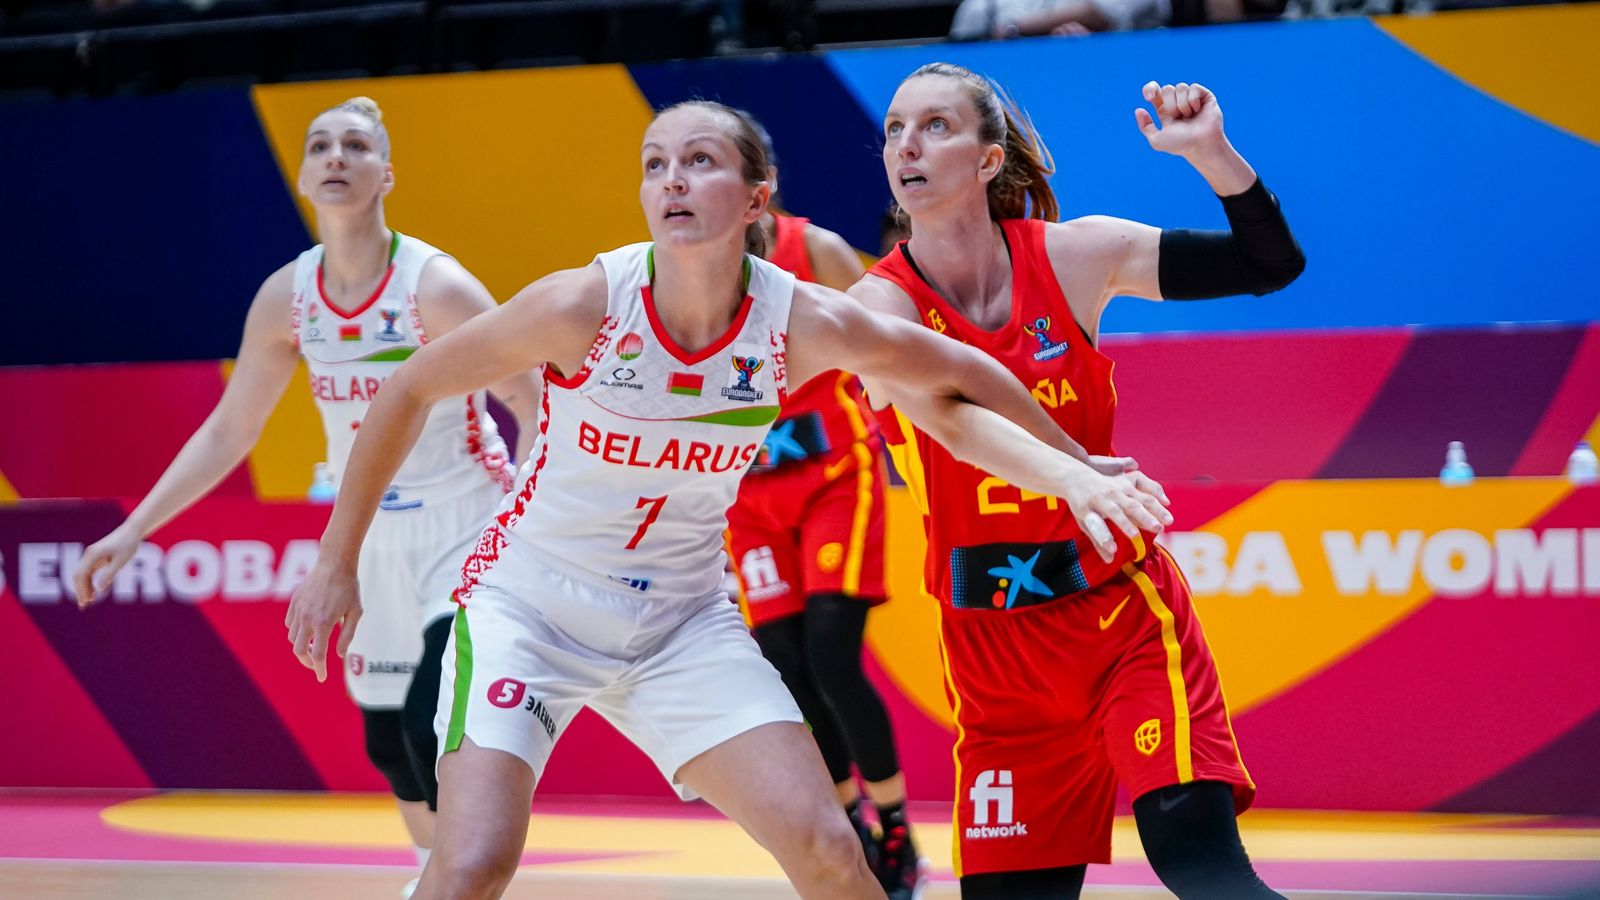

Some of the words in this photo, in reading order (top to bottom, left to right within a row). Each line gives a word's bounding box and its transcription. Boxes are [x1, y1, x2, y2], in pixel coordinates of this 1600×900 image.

[312, 375, 386, 401] BELAR
[578, 420, 757, 473] BELARUS
[624, 495, 668, 550] 7
[1154, 530, 1304, 596] BA
[497, 682, 517, 702] 5
[970, 770, 1013, 824] fi
[966, 822, 1027, 838] network
